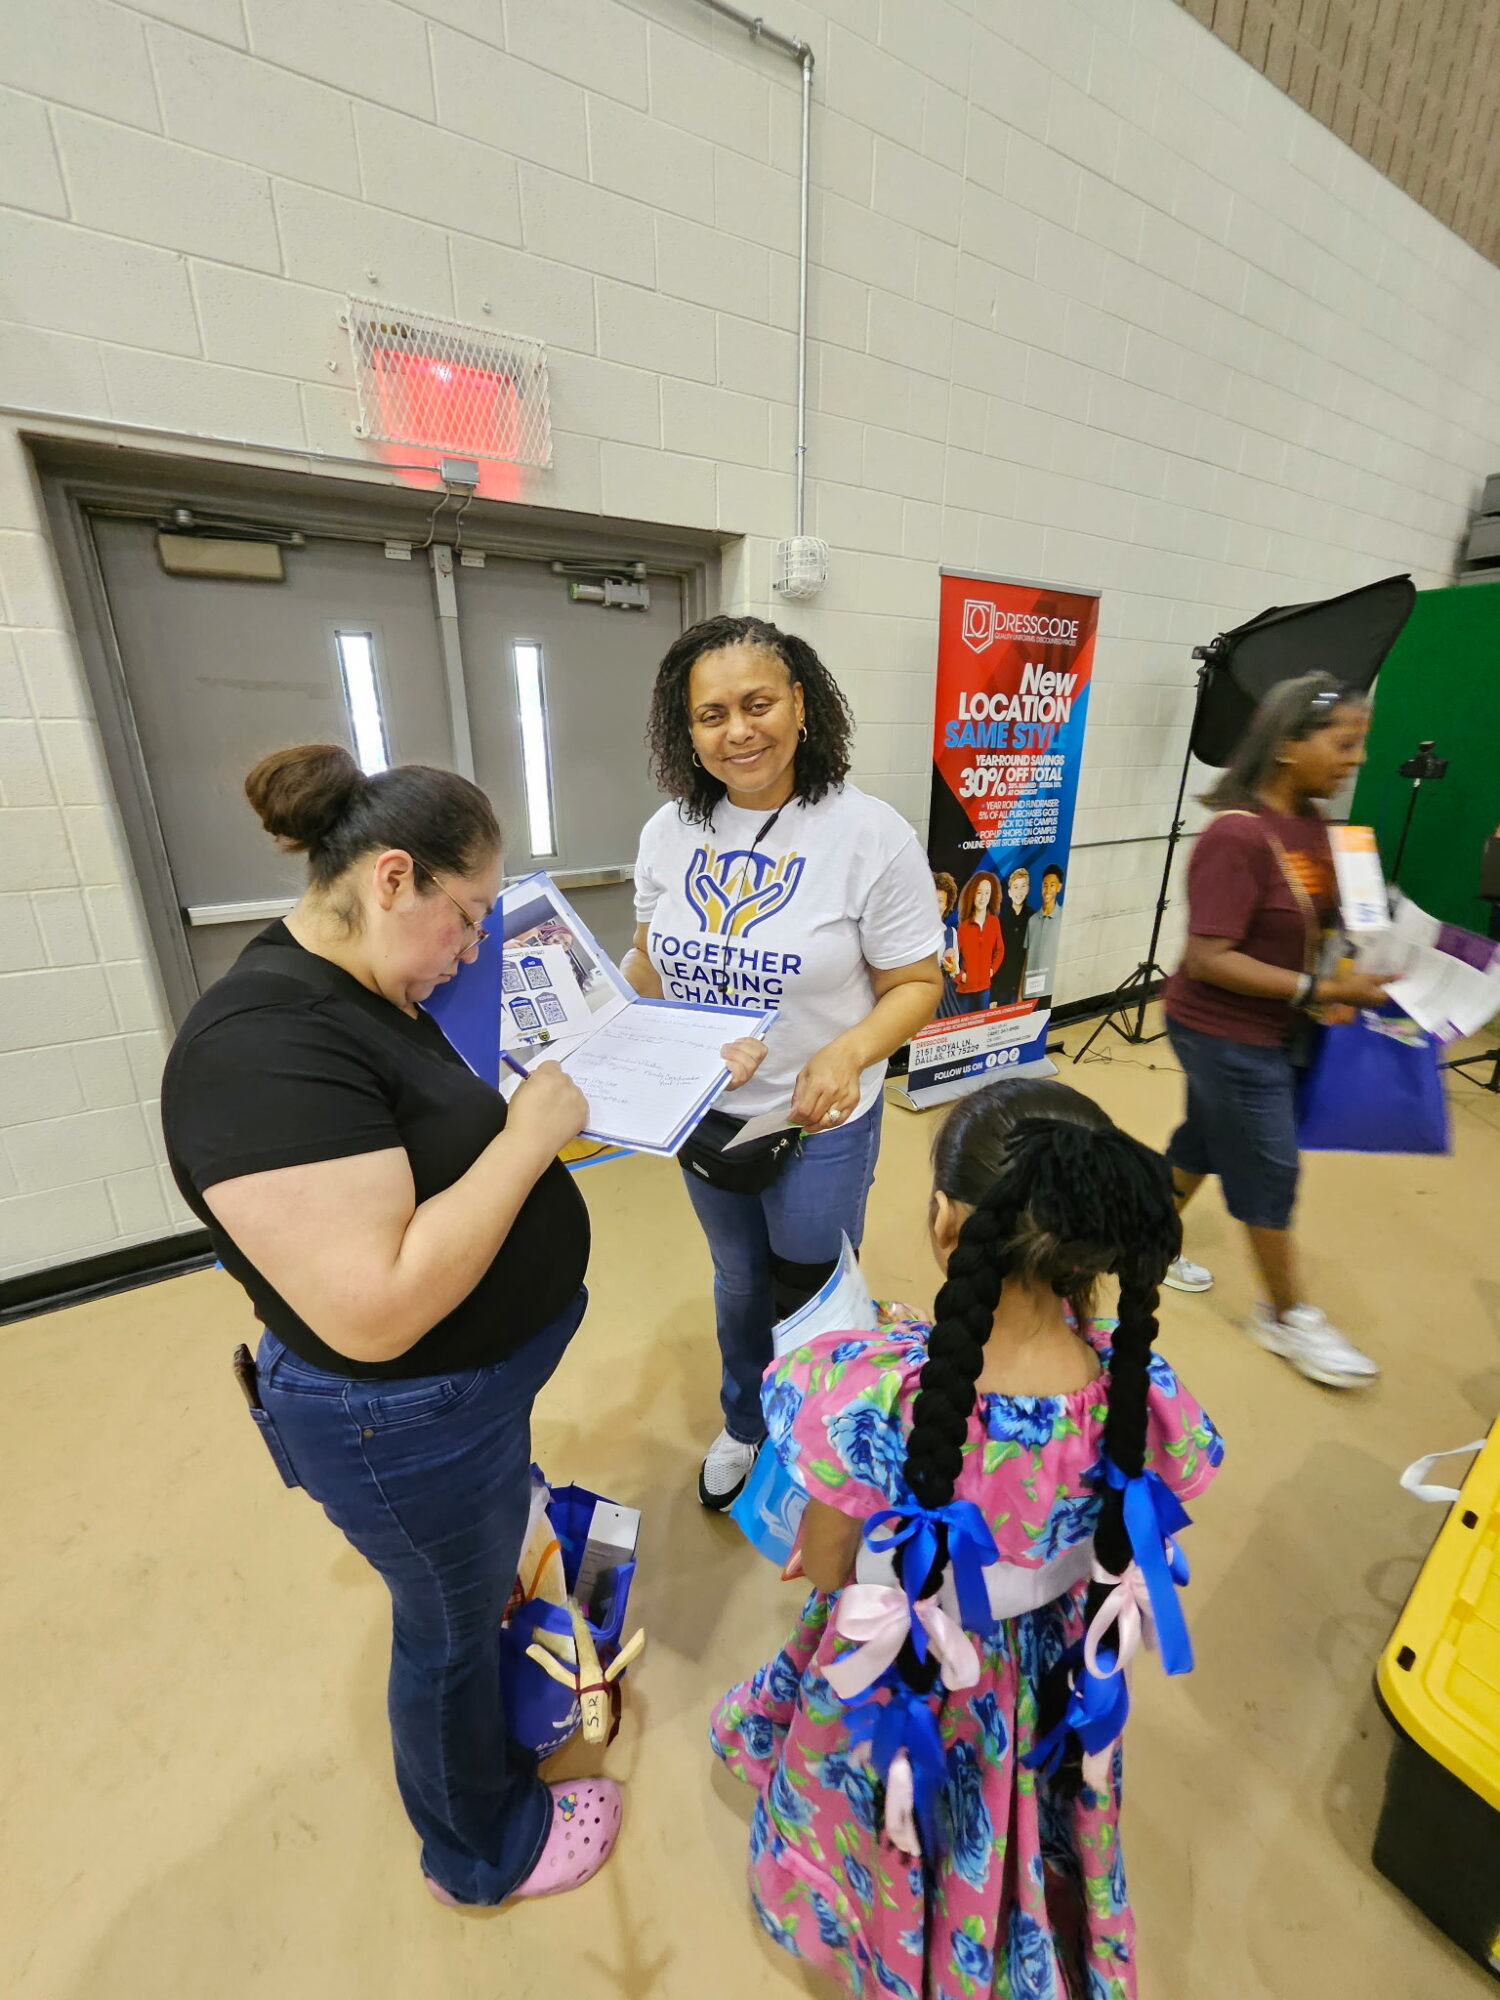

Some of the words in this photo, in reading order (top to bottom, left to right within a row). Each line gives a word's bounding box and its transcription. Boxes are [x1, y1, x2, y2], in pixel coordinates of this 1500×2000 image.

[994, 611, 1079, 638] DRESSCODE
[1019, 662, 1079, 696] New
[958, 691, 1072, 723] LOCATION
[944, 720, 1009, 748] SAME
[1012, 722, 1068, 749] STYLE
[975, 754, 1030, 766] YEAR-ROUND
[1031, 755, 1065, 766] SAVINGS
[959, 767, 1007, 798] 30%
[1006, 767, 1029, 782] OFF
[1029, 767, 1063, 782] TOTAL
[989, 811, 999, 820] OF
[1009, 808, 1042, 819] PURCHASES
[1042, 808, 1059, 817] GOES
[997, 820, 1015, 829] BACK
[1015, 819, 1025, 828] TO
[1034, 817, 1058, 826] CAMPUS
[1002, 828, 1023, 838] SHOPS
[1023, 828, 1033, 837] ON
[1033, 826, 1057, 836] CAMPUS
[962, 840, 986, 850] ONLINE
[1001, 838, 1020, 847] STORE
[652, 932, 802, 975] TOGETHER
[660, 958, 783, 995] LEADING
[915, 1048, 934, 1058] 2151
[936, 1042, 960, 1053] ROYAL
[947, 1049, 956, 1059] TX
[933, 1067, 962, 1081] FOLLOW
[962, 1064, 973, 1073] US
[972, 1061, 984, 1070] ON
